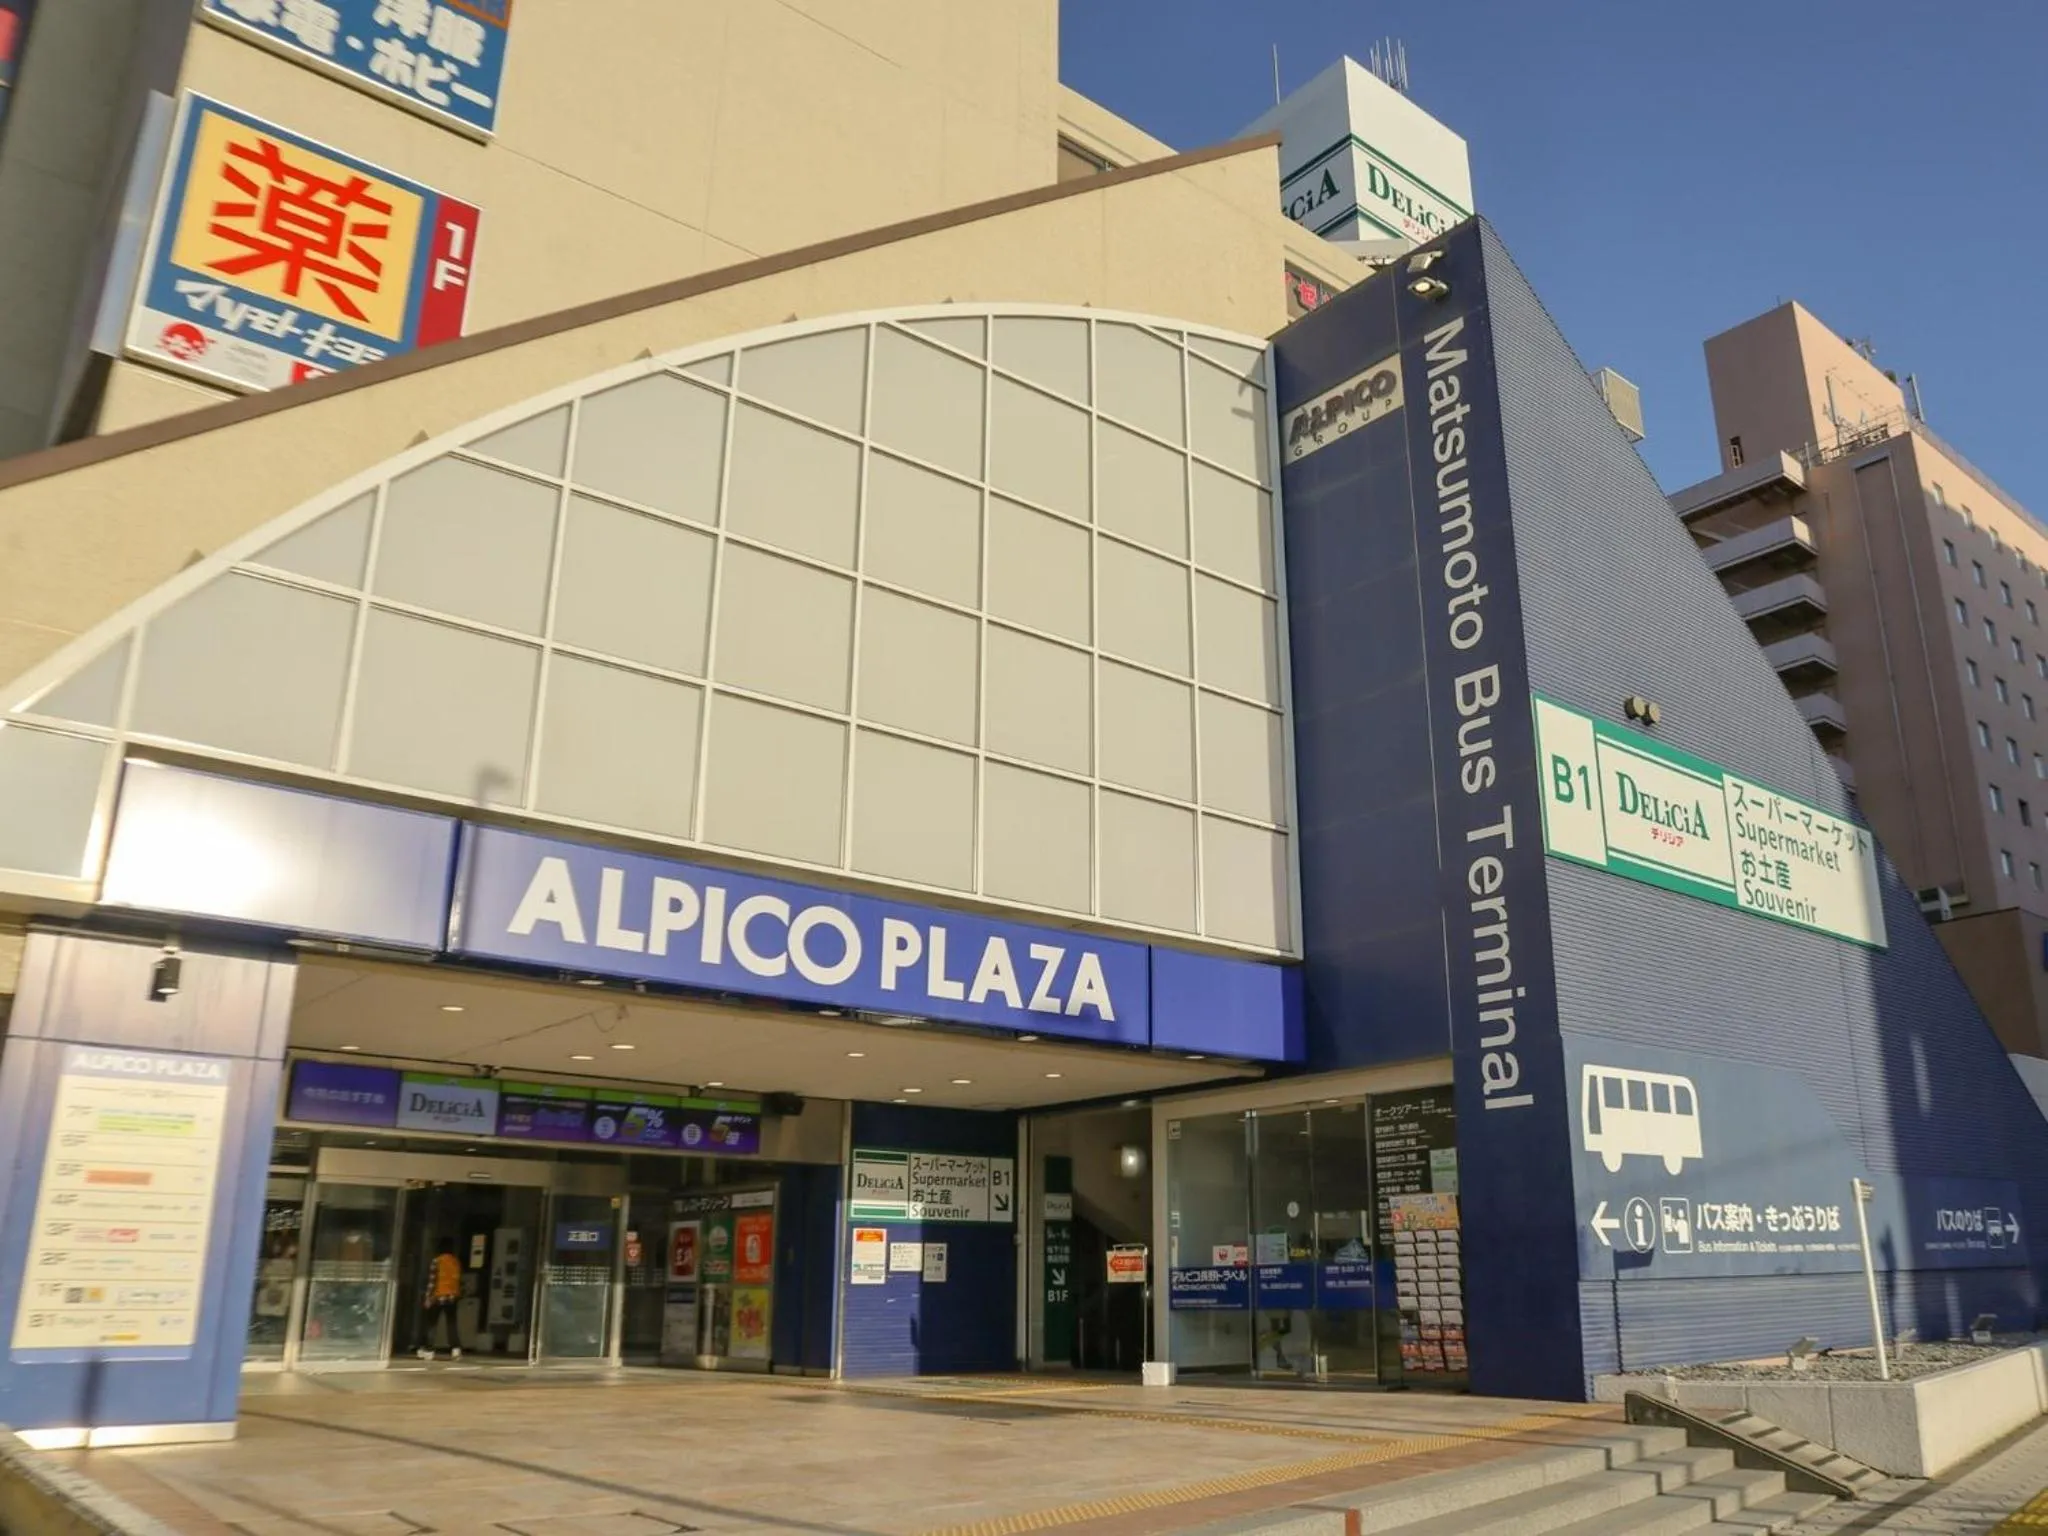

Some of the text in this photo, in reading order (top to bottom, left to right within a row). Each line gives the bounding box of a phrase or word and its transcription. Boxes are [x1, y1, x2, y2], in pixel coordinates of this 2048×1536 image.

[1281, 168, 1340, 221] CiA
[206, 138, 394, 324] 薬
[432, 222, 467, 291] 1F
[1289, 369, 1397, 447] ALPICO
[1293, 398, 1393, 457] GROUP
[1422, 315, 1535, 1110] Matsumoto Bus Terminal
[1551, 754, 1592, 811] B1
[1731, 781, 1868, 854] スーパーマーケット
[1735, 812, 1841, 873] Supermarket
[1741, 850, 1793, 891] お土産
[1743, 879, 1817, 924] Souvenir
[505, 855, 1116, 1023] ALPICO PLAZA
[155, 1058, 222, 1079] PLAZA
[911, 1172, 987, 1188] Supermarket
[912, 1156, 987, 1174] スーパーマーケット
[992, 1171, 1010, 1186] B1
[911, 1205, 970, 1219] Souvenir
[912, 1189, 952, 1205] お土産
[1696, 1202, 1841, 1232] バス案内・きっぷうりば
[1936, 1208, 1984, 1232] バスのりば
